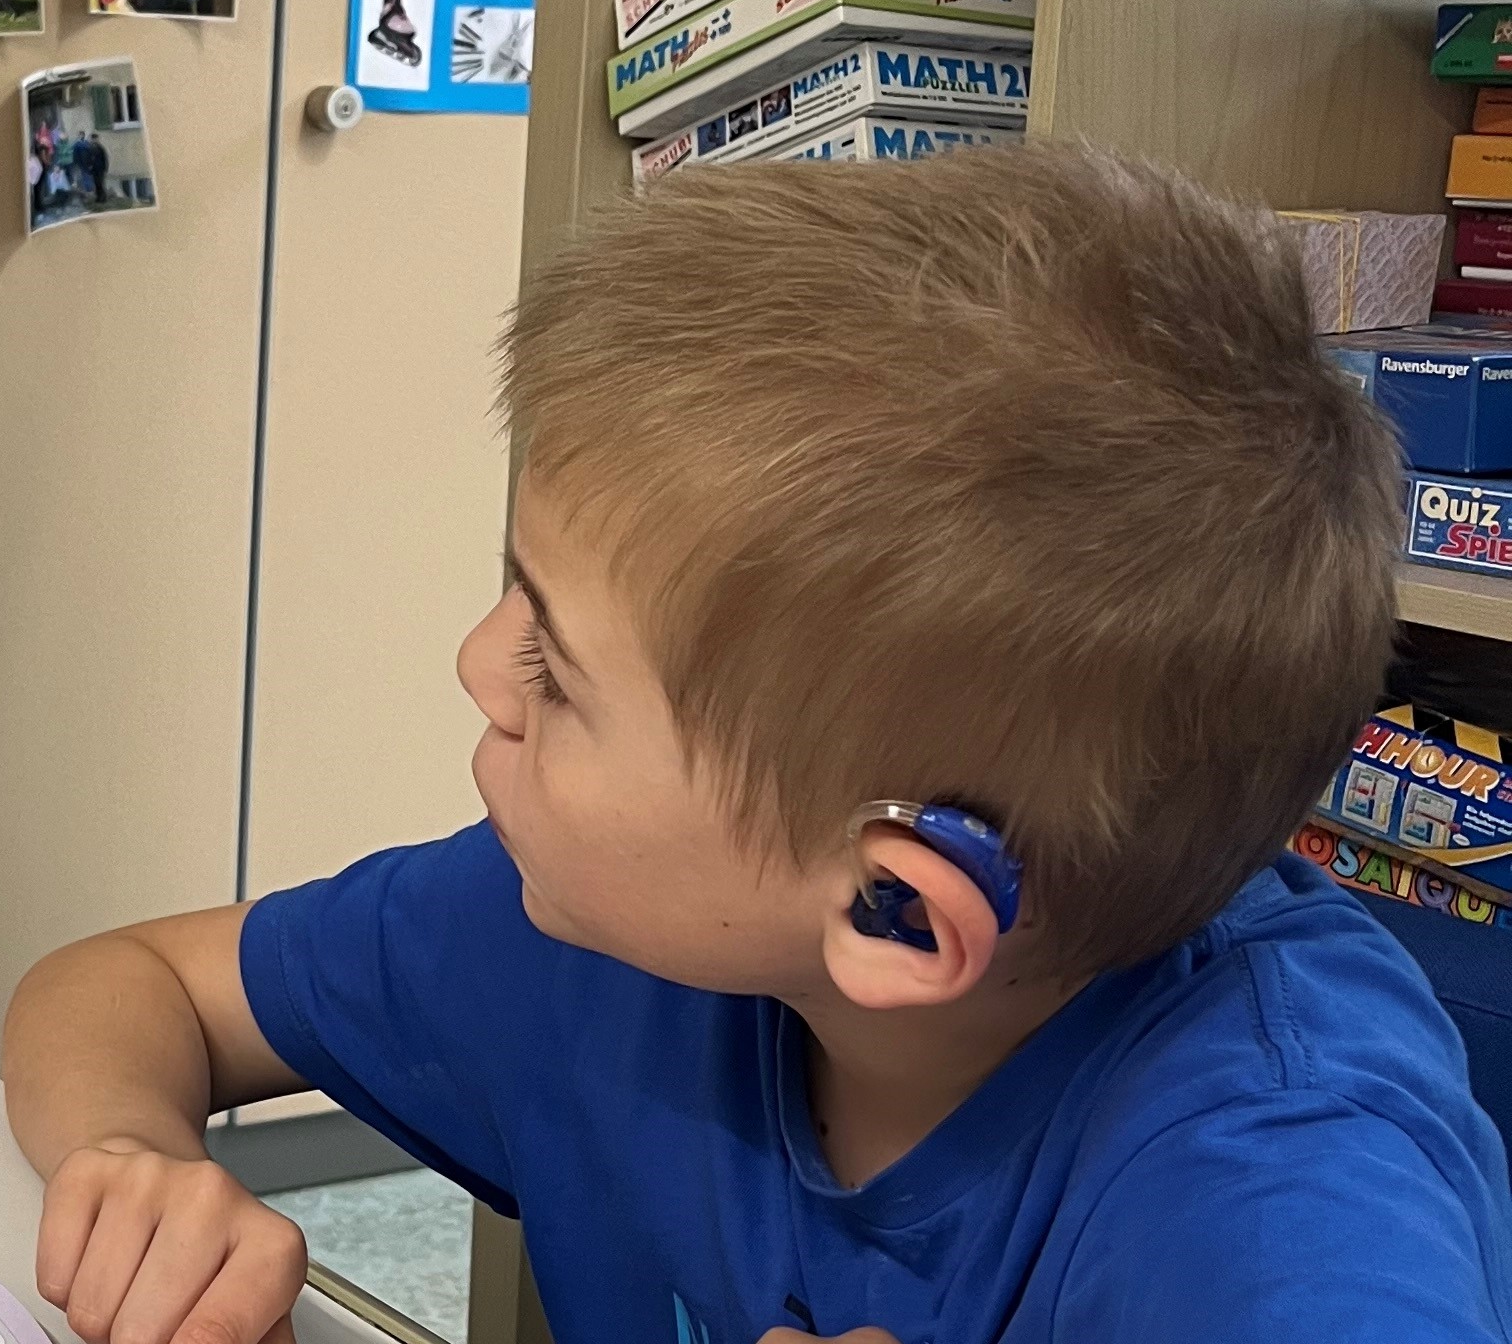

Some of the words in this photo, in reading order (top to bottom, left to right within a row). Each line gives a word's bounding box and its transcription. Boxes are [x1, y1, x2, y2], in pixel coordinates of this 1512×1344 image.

[615, 27, 690, 92] MATH
[792, 59, 849, 99] MATH
[850, 53, 862, 72] 2
[876, 50, 998, 98] MATH
[1000, 64, 1024, 98] 2
[1381, 357, 1470, 378] Ravensburger
[1482, 366, 1512, 381] Rave
[1380, 733, 1500, 803] HOUR
